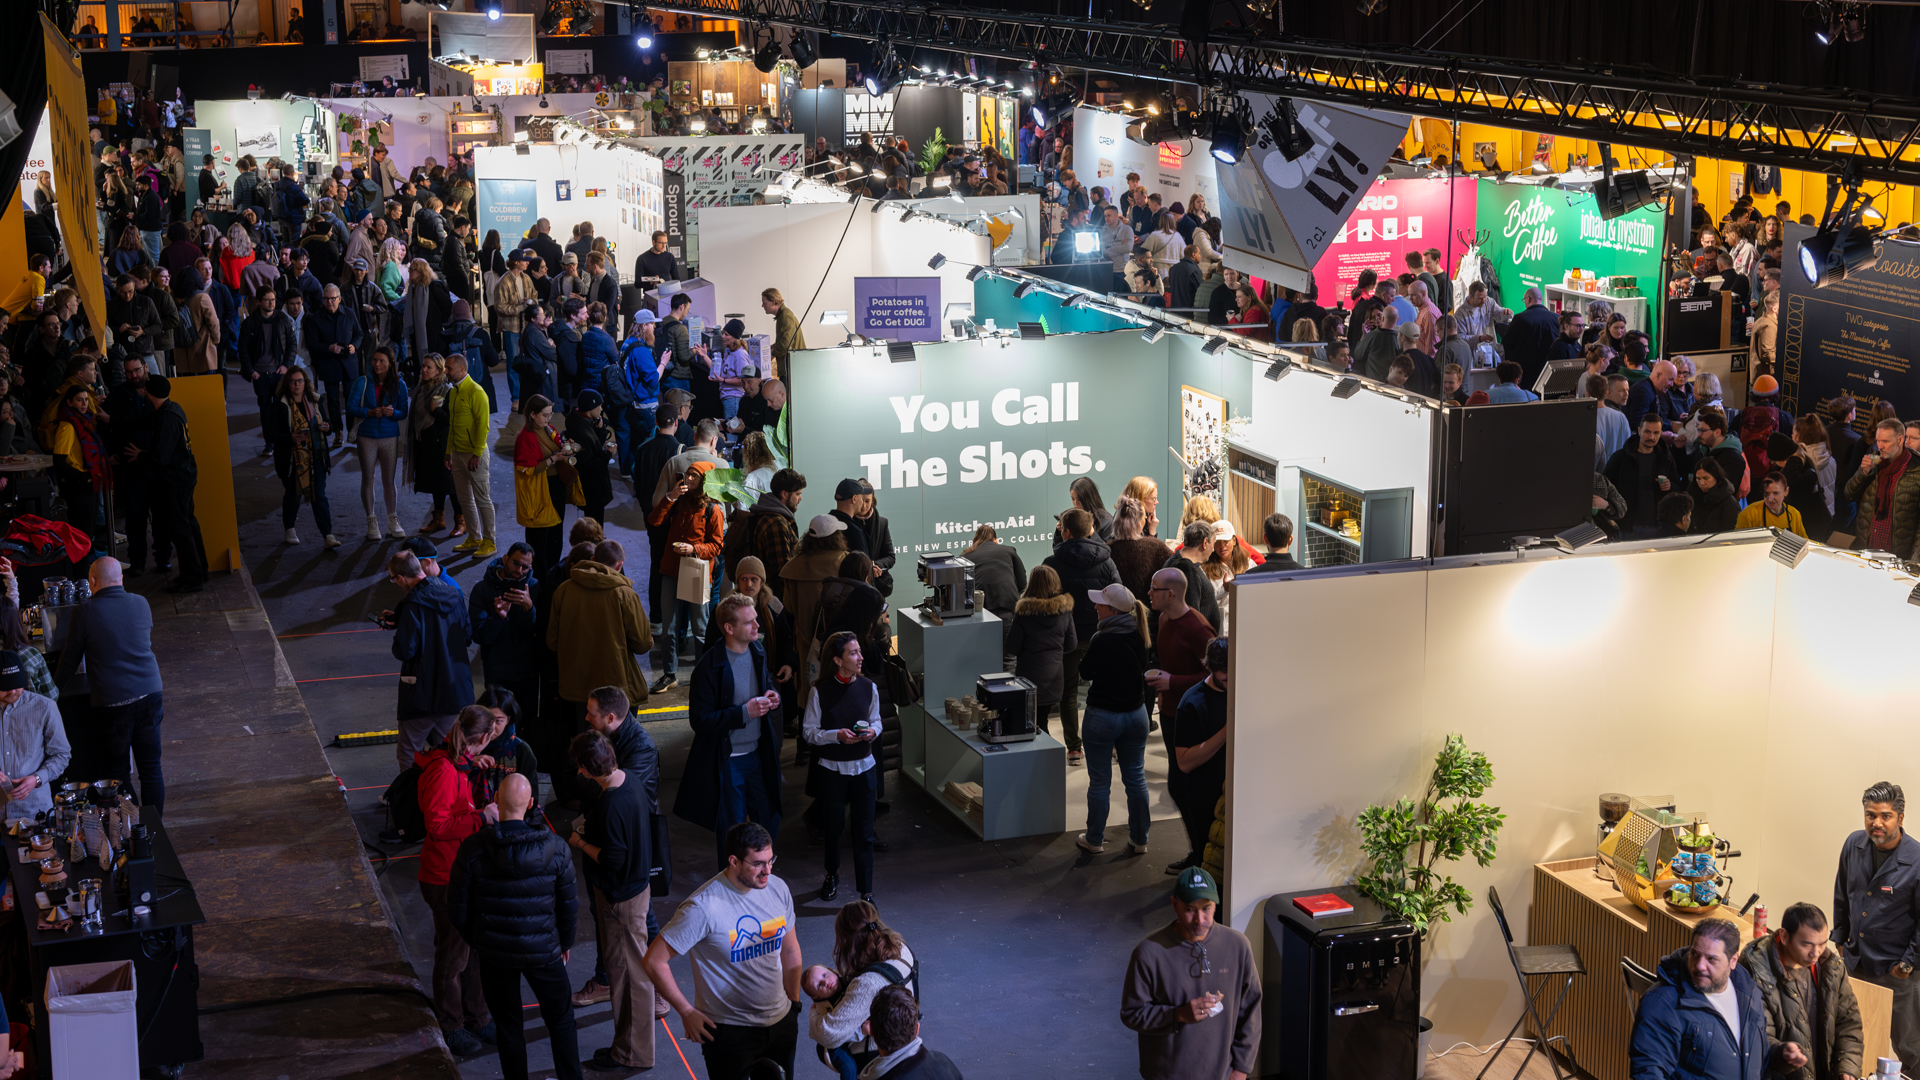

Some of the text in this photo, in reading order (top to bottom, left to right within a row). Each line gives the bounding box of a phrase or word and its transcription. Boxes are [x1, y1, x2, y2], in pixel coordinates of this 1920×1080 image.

[328, 18, 334, 26] 5
[1258, 110, 1276, 130] THE
[846, 137, 893, 146] MAZE
[1304, 141, 1369, 216] LY!
[1356, 195, 1398, 211] ARIO
[1503, 194, 1555, 238] Better
[1237, 206, 1276, 254] LY!
[1580, 209, 1655, 249] johan & nyström
[1513, 223, 1558, 265] Coffee
[1873, 245, 1920, 279] Roaste
[894, 308, 925, 316] coffee.
[1846, 312, 1863, 325] TWO
[889, 381, 1079, 434] You Call
[860, 440, 1106, 491] The Shots.
[894, 544, 908, 554] HE
[915, 543, 941, 552] NEW
[1010, 532, 1053, 544] COLLEC
[730, 937, 782, 963] MARMO
[1347, 956, 1400, 970] SMEG
